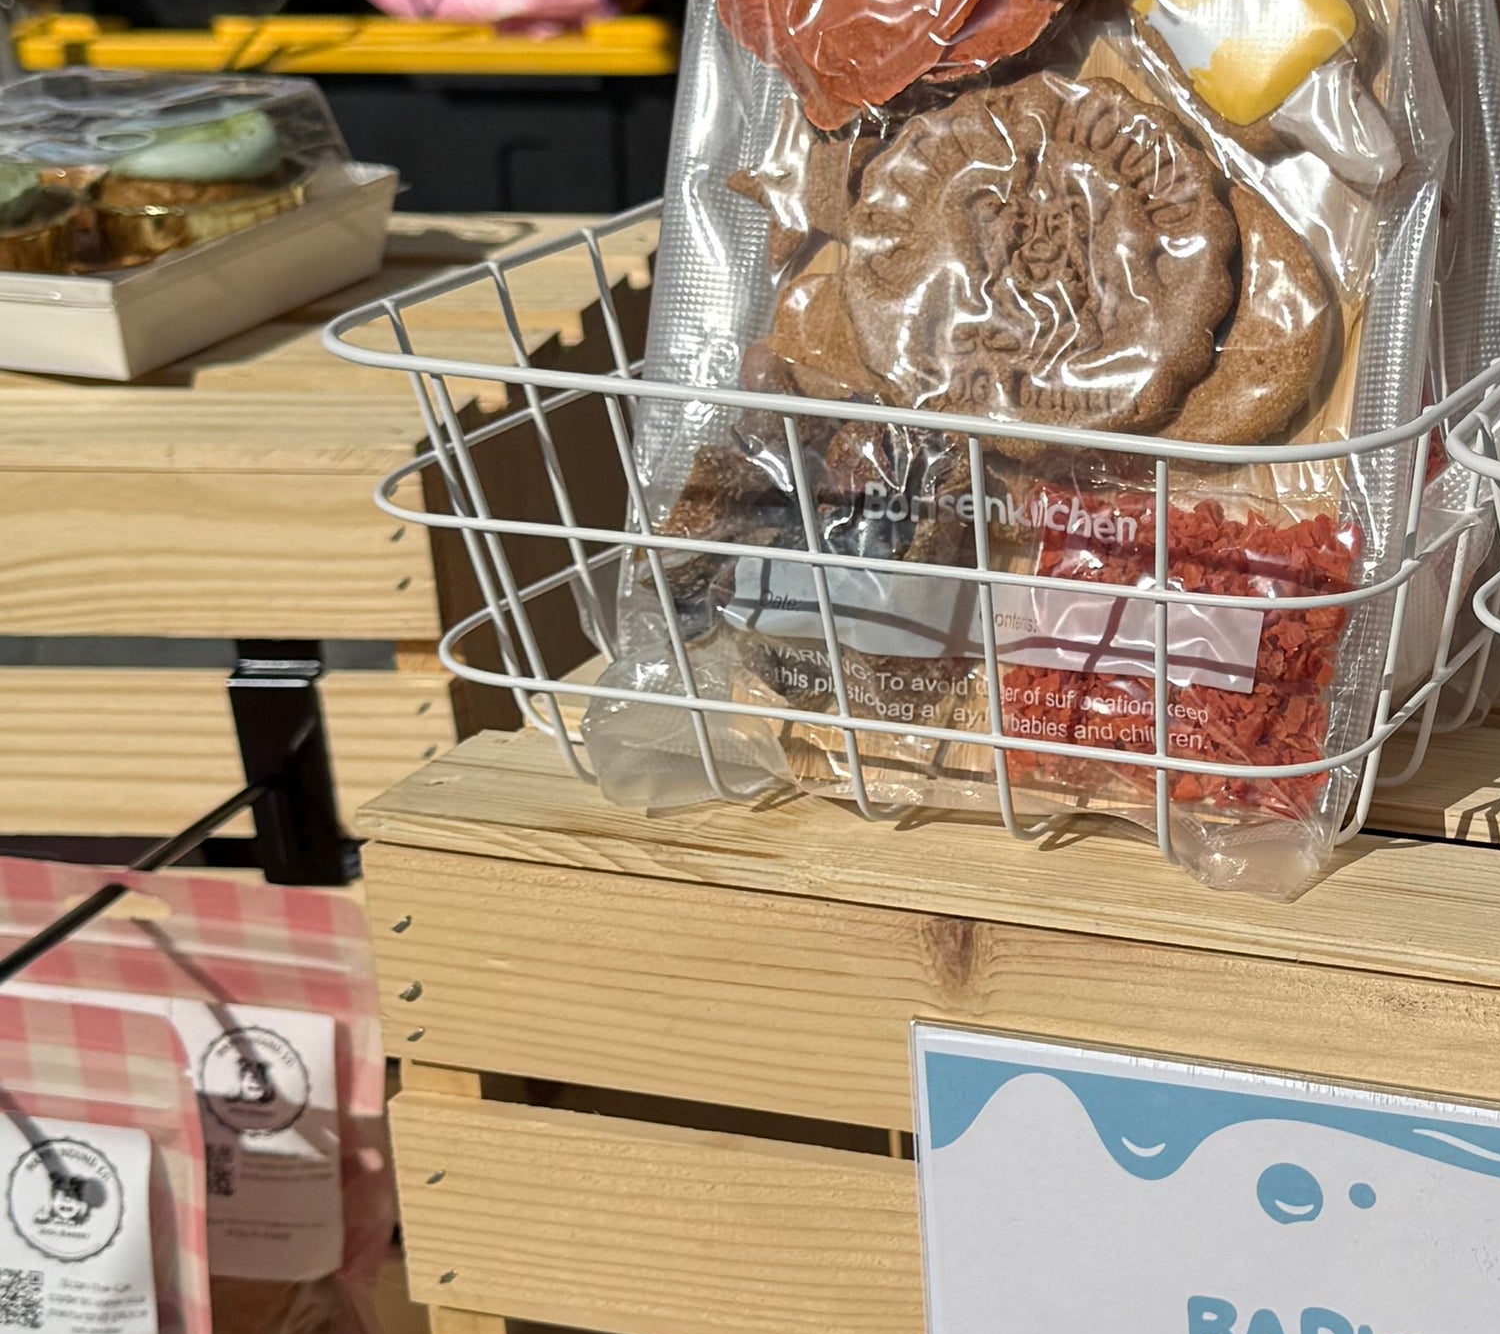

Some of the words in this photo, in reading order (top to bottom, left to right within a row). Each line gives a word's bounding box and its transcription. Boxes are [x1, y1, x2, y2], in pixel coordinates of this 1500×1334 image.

[979, 610, 1037, 634] ontents:
[763, 643, 872, 684] WARNNG:
[875, 671, 904, 692] To
[911, 674, 969, 696] avoid
[1024, 687, 1040, 704] of
[1045, 690, 1153, 717] sufoation
[775, 667, 808, 689] this
[815, 676, 877, 707] plstic
[876, 697, 915, 720] bag
[921, 702, 974, 730] aay
[1010, 715, 1068, 738] babies
[1074, 721, 1113, 742] and
[1119, 723, 1209, 750] chilren.
